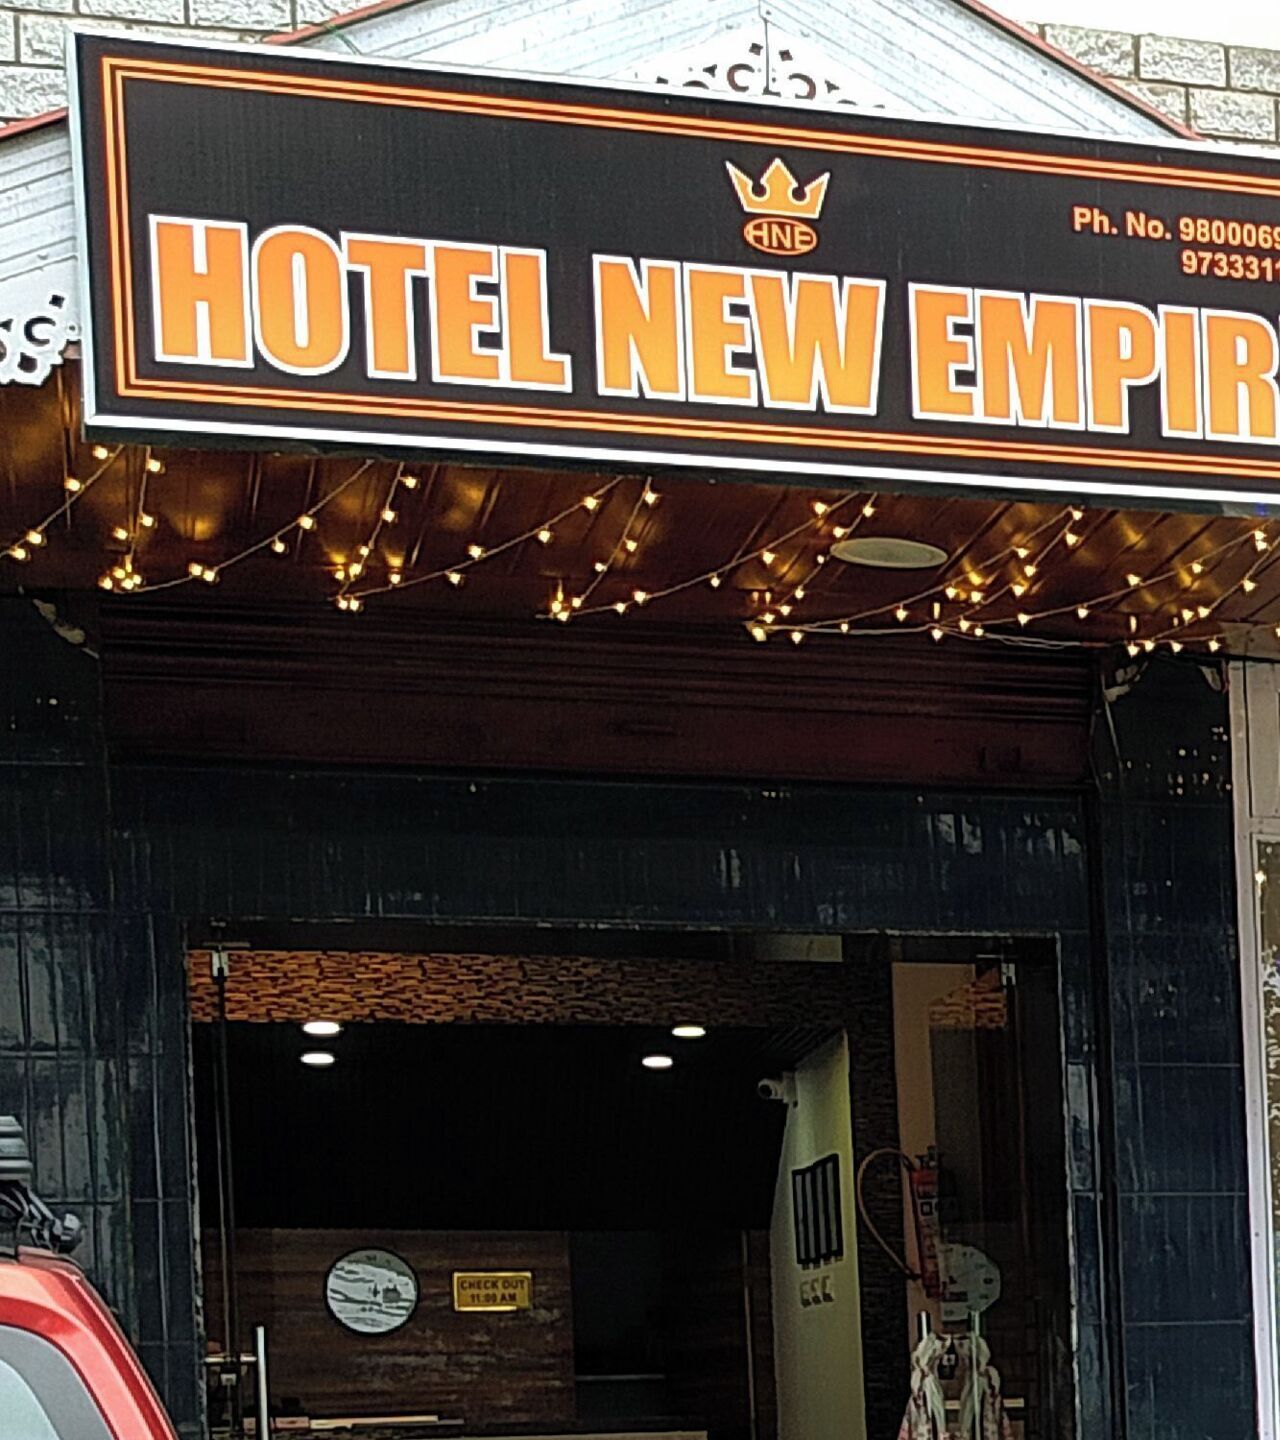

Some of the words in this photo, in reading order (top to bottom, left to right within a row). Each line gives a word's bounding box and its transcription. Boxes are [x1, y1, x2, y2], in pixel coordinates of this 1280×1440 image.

[746, 222, 814, 250] HNE
[1072, 206, 1118, 236] Ph.
[1125, 210, 1172, 241] No.
[148, 214, 573, 393] HOTEL
[592, 254, 887, 416] NEW
[460, 1279, 499, 1291] CHECK
[501, 1279, 526, 1290] OUT
[500, 1291, 517, 1302] AM
